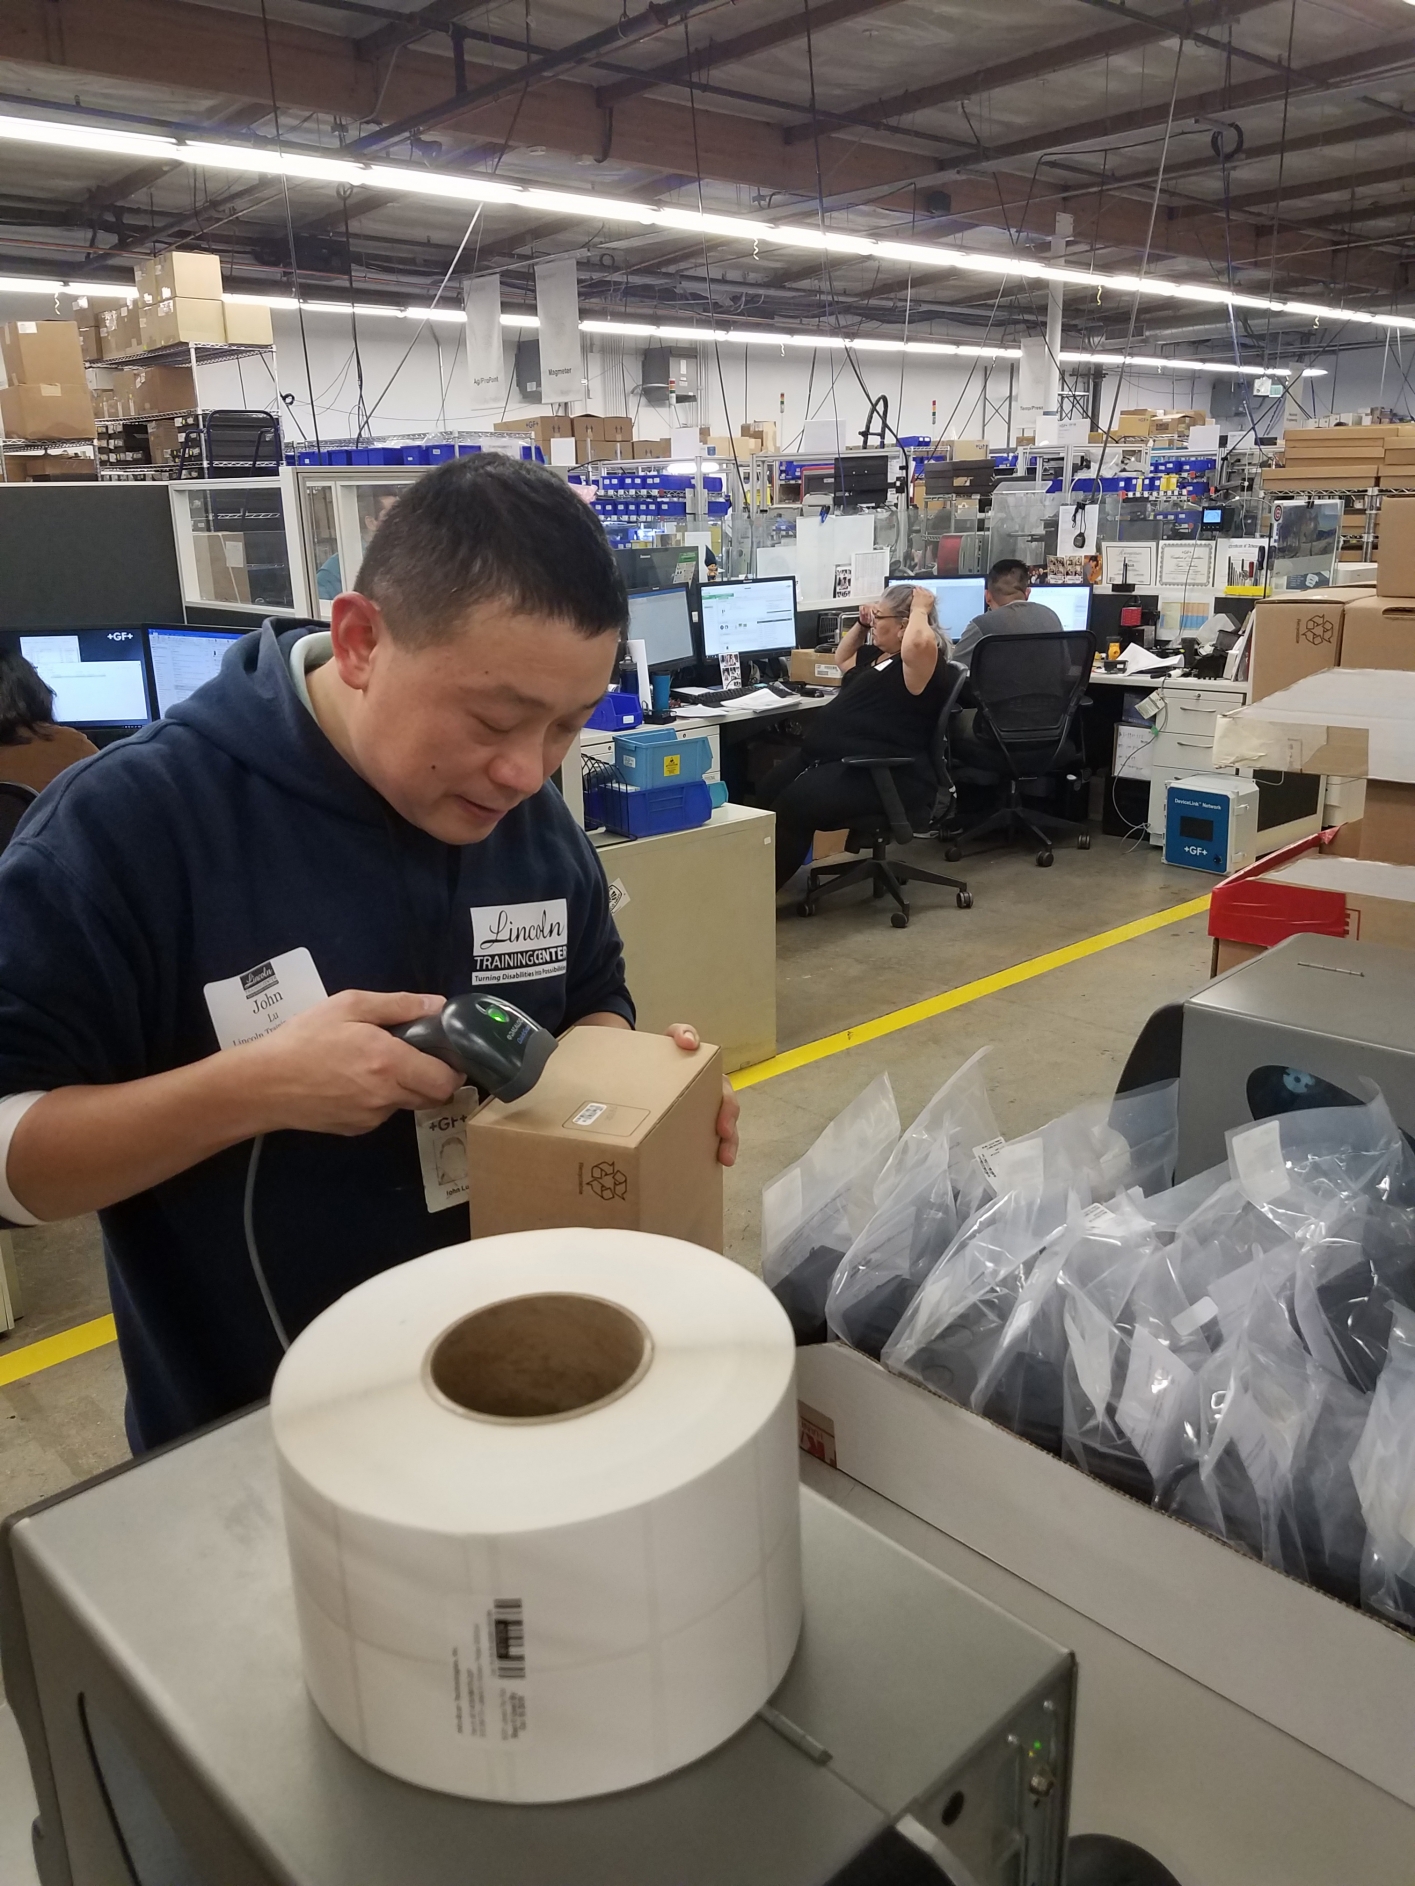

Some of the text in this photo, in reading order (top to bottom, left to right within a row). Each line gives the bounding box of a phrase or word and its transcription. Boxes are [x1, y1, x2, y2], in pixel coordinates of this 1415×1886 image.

[548, 367, 572, 377] Magmeter
[107, 632, 134, 641] +GF+
[1202, 802, 1222, 810] Network
[1184, 846, 1207, 856] +GF+
[480, 909, 565, 950] Lincoln
[245, 968, 273, 989] Lincoln
[474, 974, 501, 982] Turning
[502, 970, 534, 980] Disabilities
[252, 991, 284, 1014] John
[267, 1011, 279, 1023] Lu
[232, 1032, 265, 1047] Lincoln
